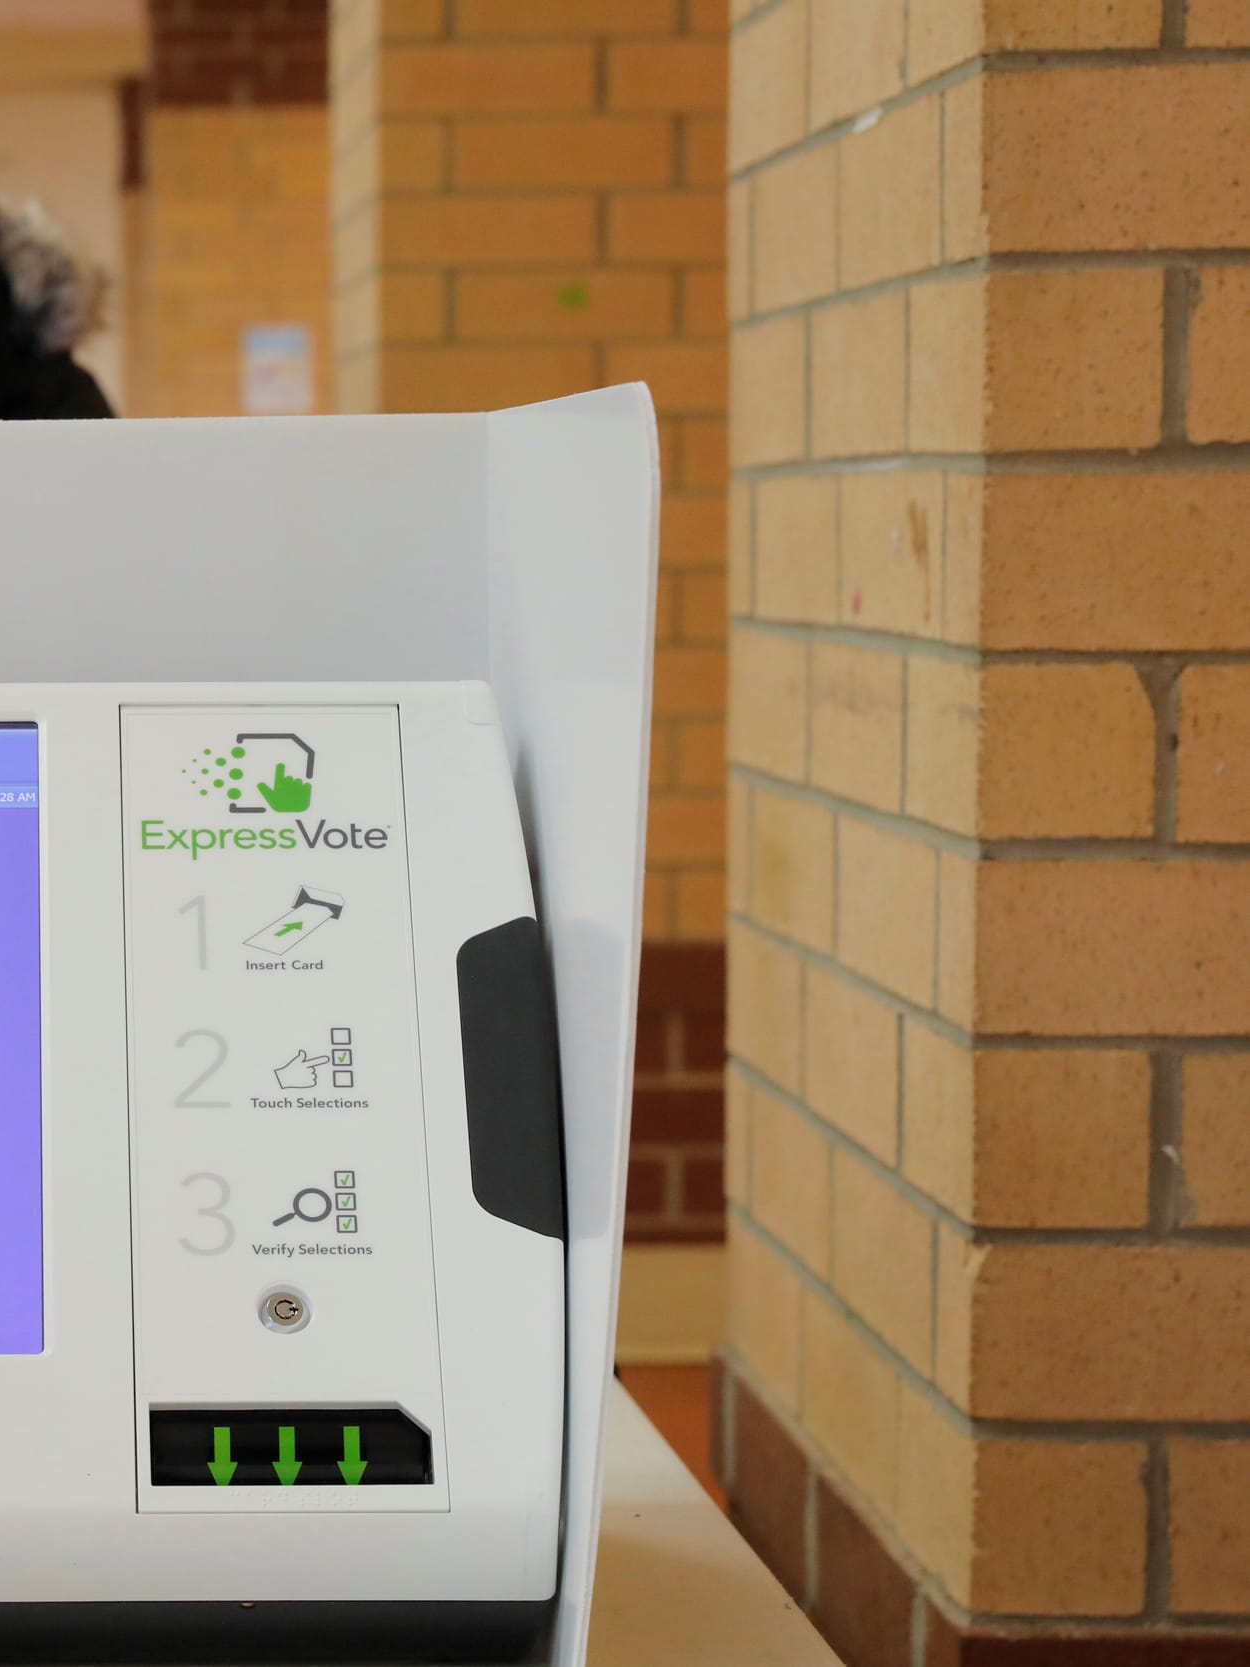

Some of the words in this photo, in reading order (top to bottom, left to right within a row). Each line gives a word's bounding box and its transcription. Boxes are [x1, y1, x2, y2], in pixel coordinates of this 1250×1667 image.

[17, 792, 36, 802] AM
[140, 819, 390, 861] ExpressVote
[177, 895, 207, 971] 1
[246, 959, 286, 971] Insert
[291, 959, 324, 971] Card
[173, 1028, 231, 1109] 2
[250, 1097, 292, 1109] Touch
[296, 1097, 369, 1109] Selections
[178, 1172, 235, 1256] 3
[252, 1243, 294, 1258] Verify
[298, 1243, 373, 1256] Selections
